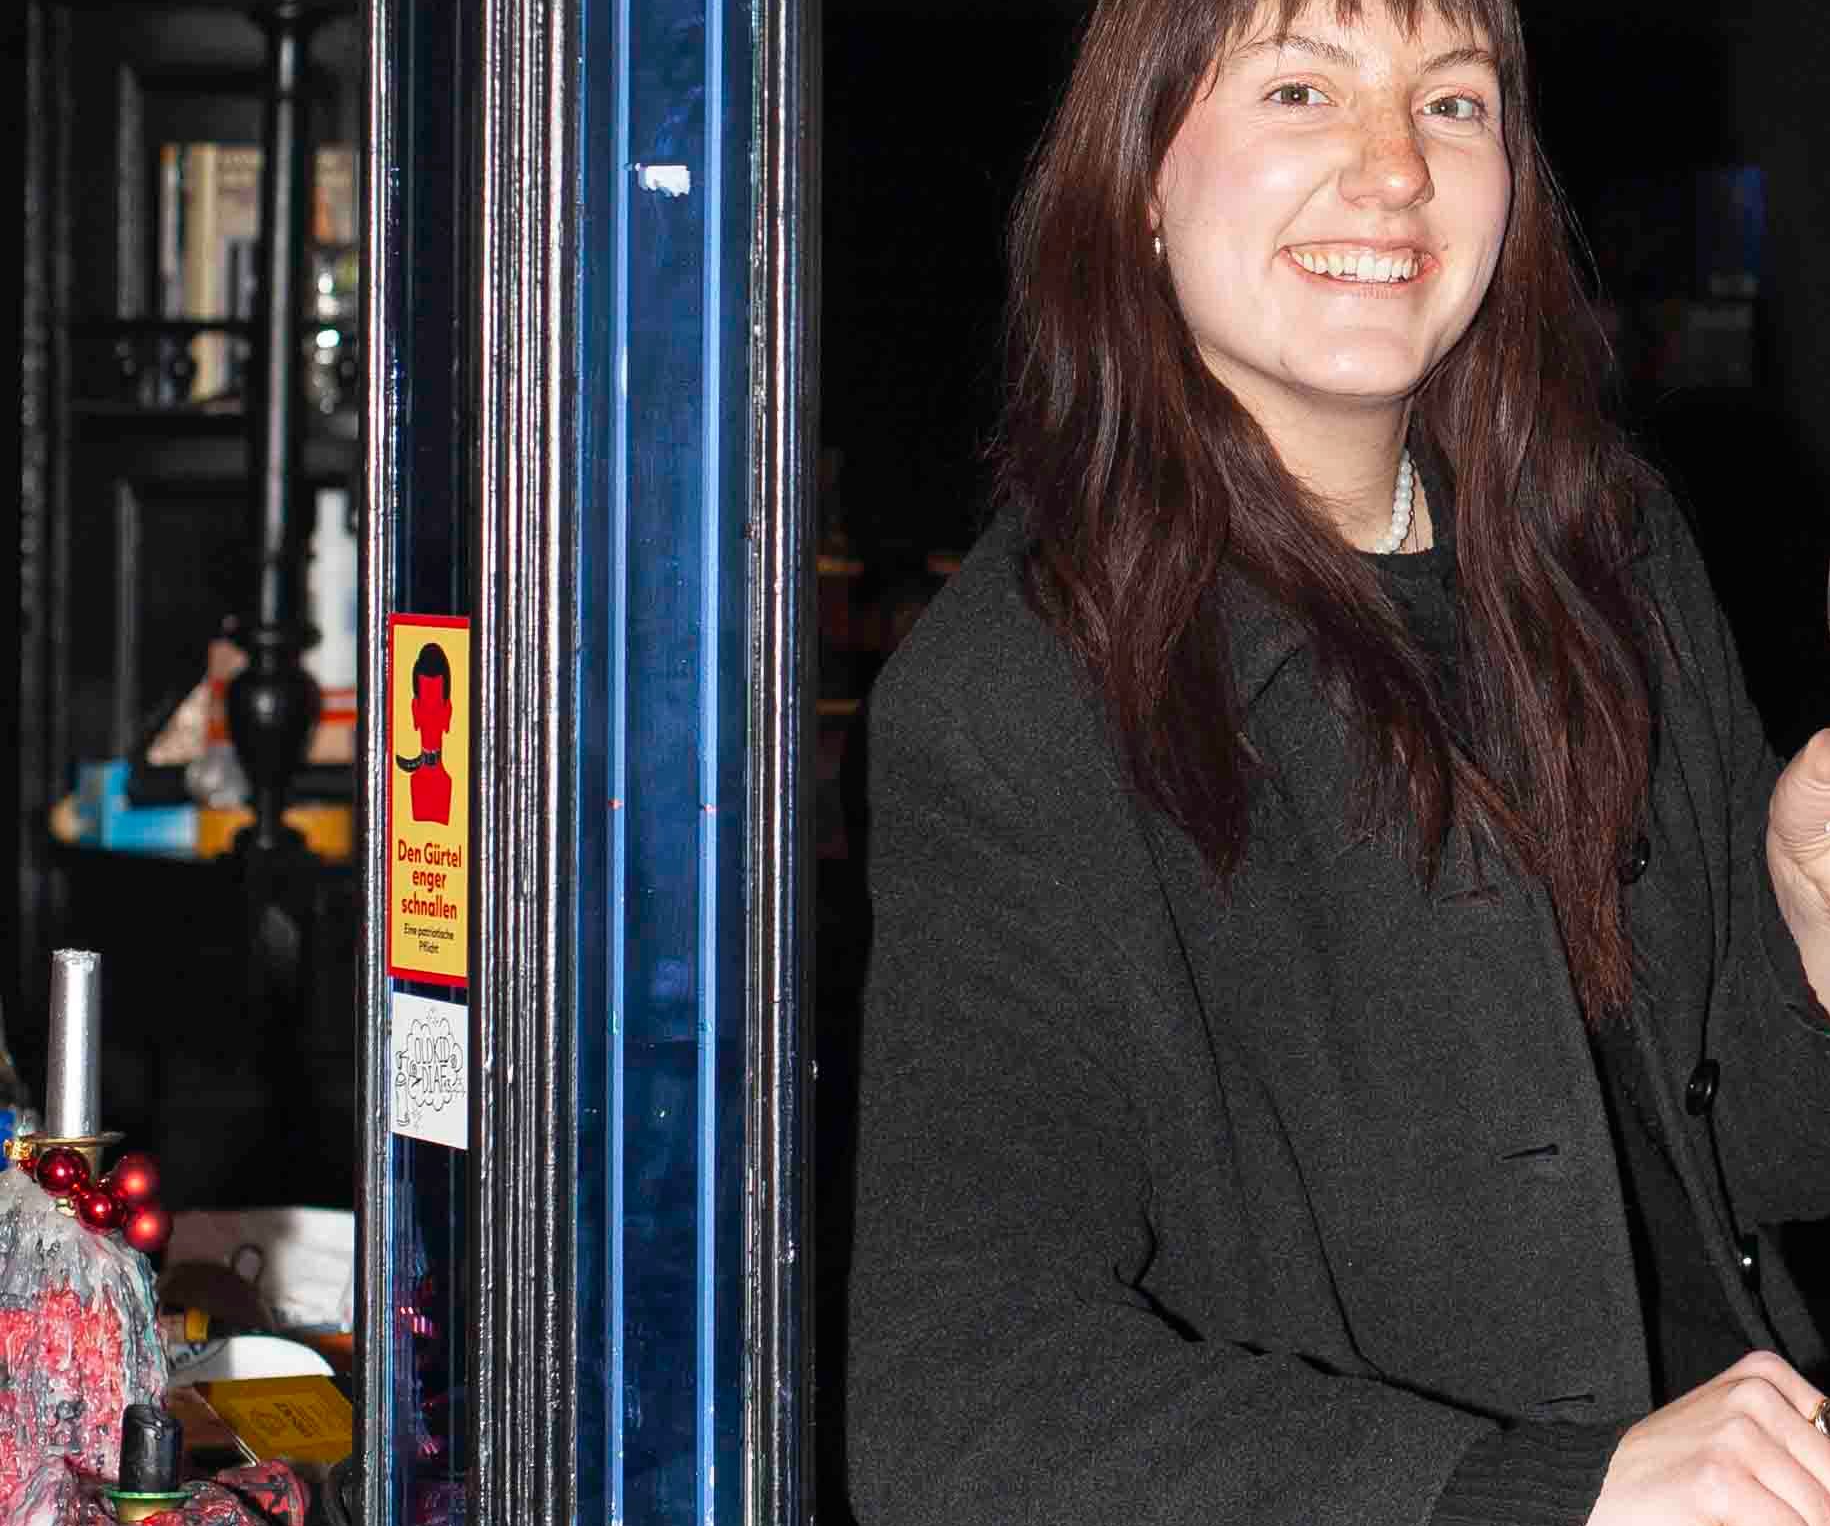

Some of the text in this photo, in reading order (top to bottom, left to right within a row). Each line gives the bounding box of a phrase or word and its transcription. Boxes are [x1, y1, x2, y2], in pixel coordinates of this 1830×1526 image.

[398, 838, 462, 867] Den Gürtel
[412, 870, 447, 892] enger
[401, 890, 457, 920] schnallen
[404, 922, 454, 941] Eine patriotische
[418, 940, 440, 954] Pflicht
